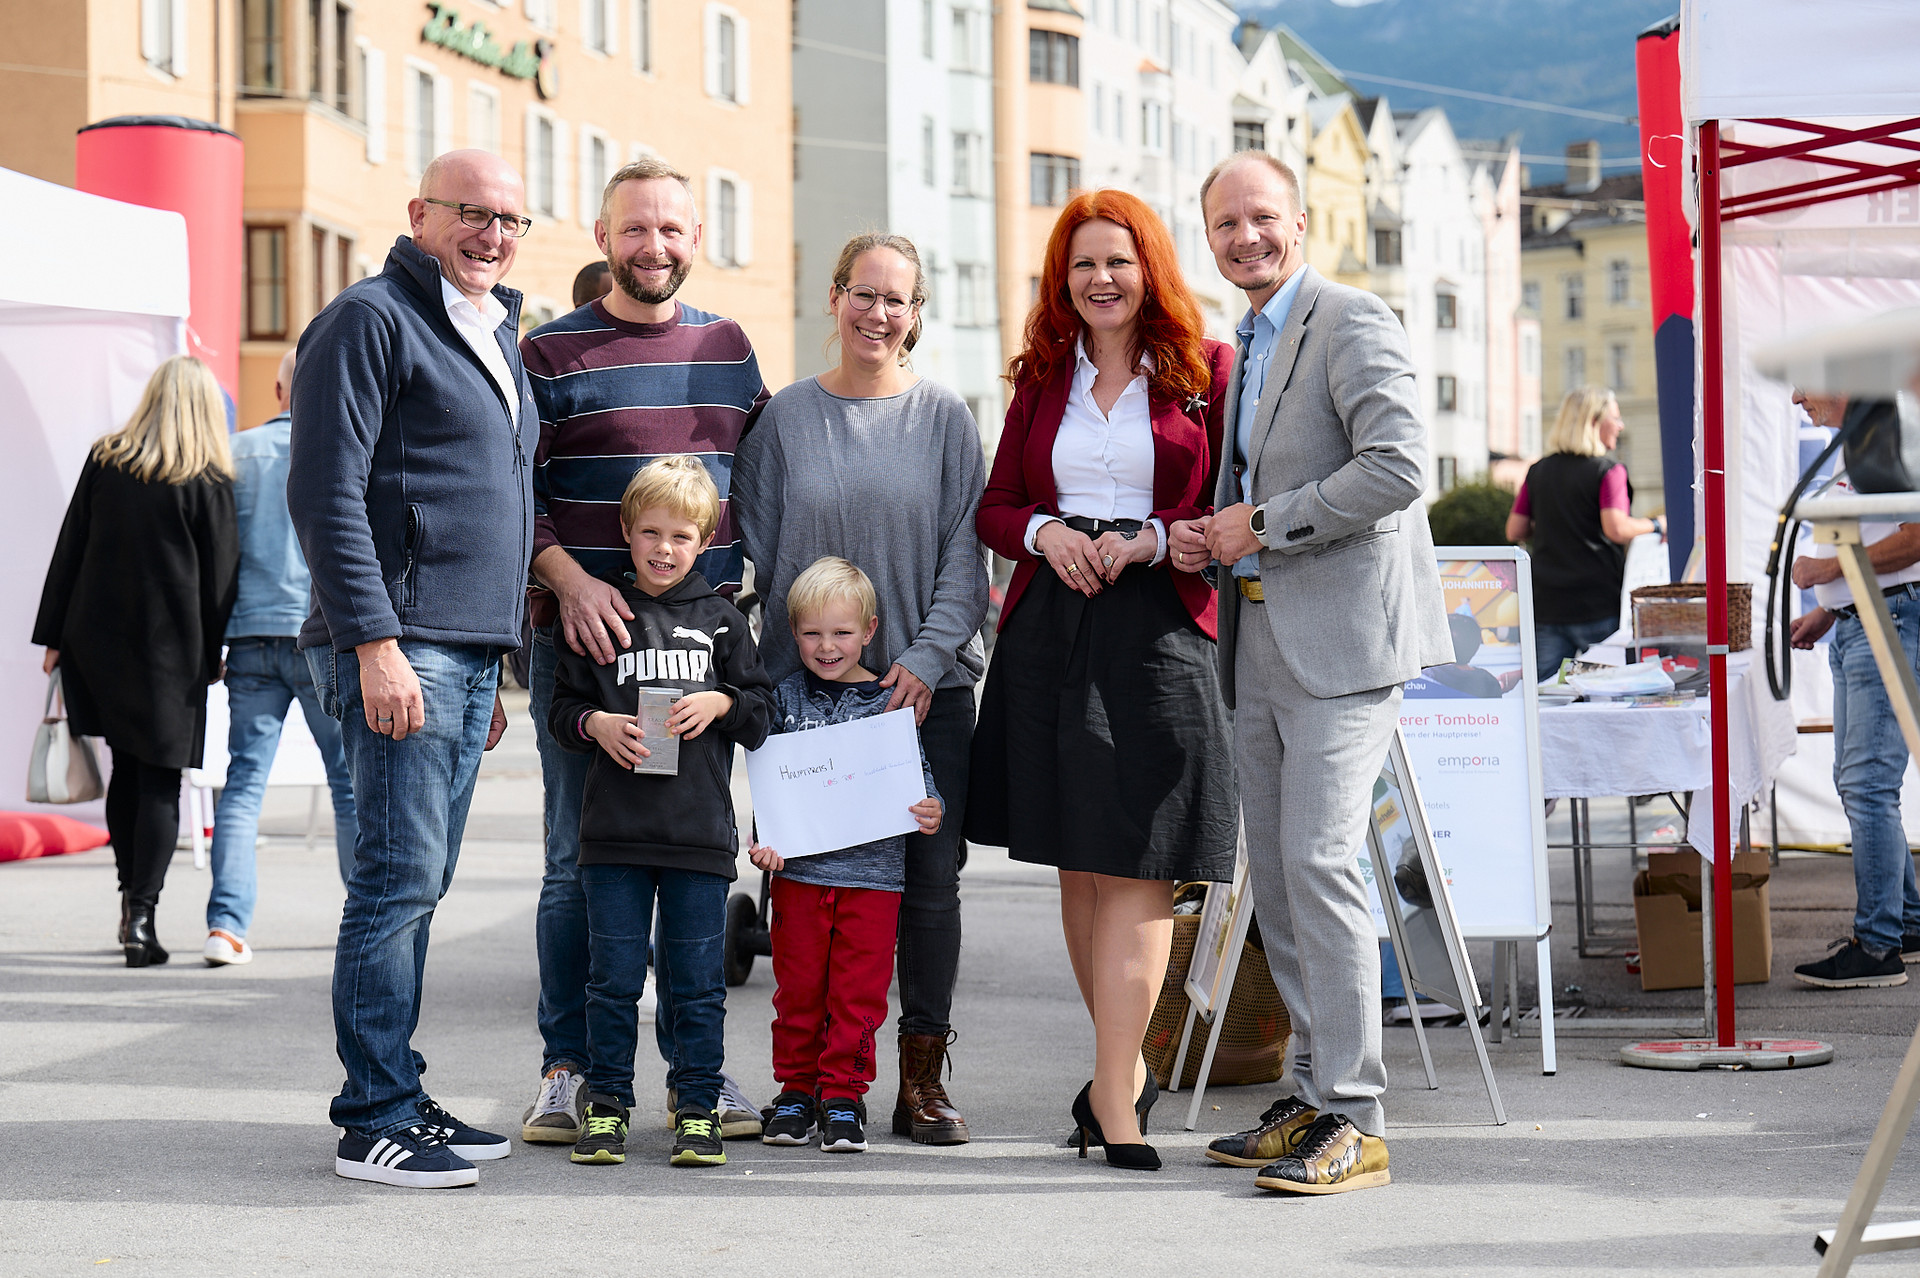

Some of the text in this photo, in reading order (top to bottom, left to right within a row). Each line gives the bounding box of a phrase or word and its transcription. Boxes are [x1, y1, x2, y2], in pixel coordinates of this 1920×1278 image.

[1443, 580, 1502, 590] JOHANNITER
[616, 648, 709, 686] PUMA
[1434, 713, 1499, 726] Tombola
[1432, 731, 1481, 740] Hauptpreise!
[1437, 755, 1500, 769] emporia
[1424, 801, 1450, 810] Hotels
